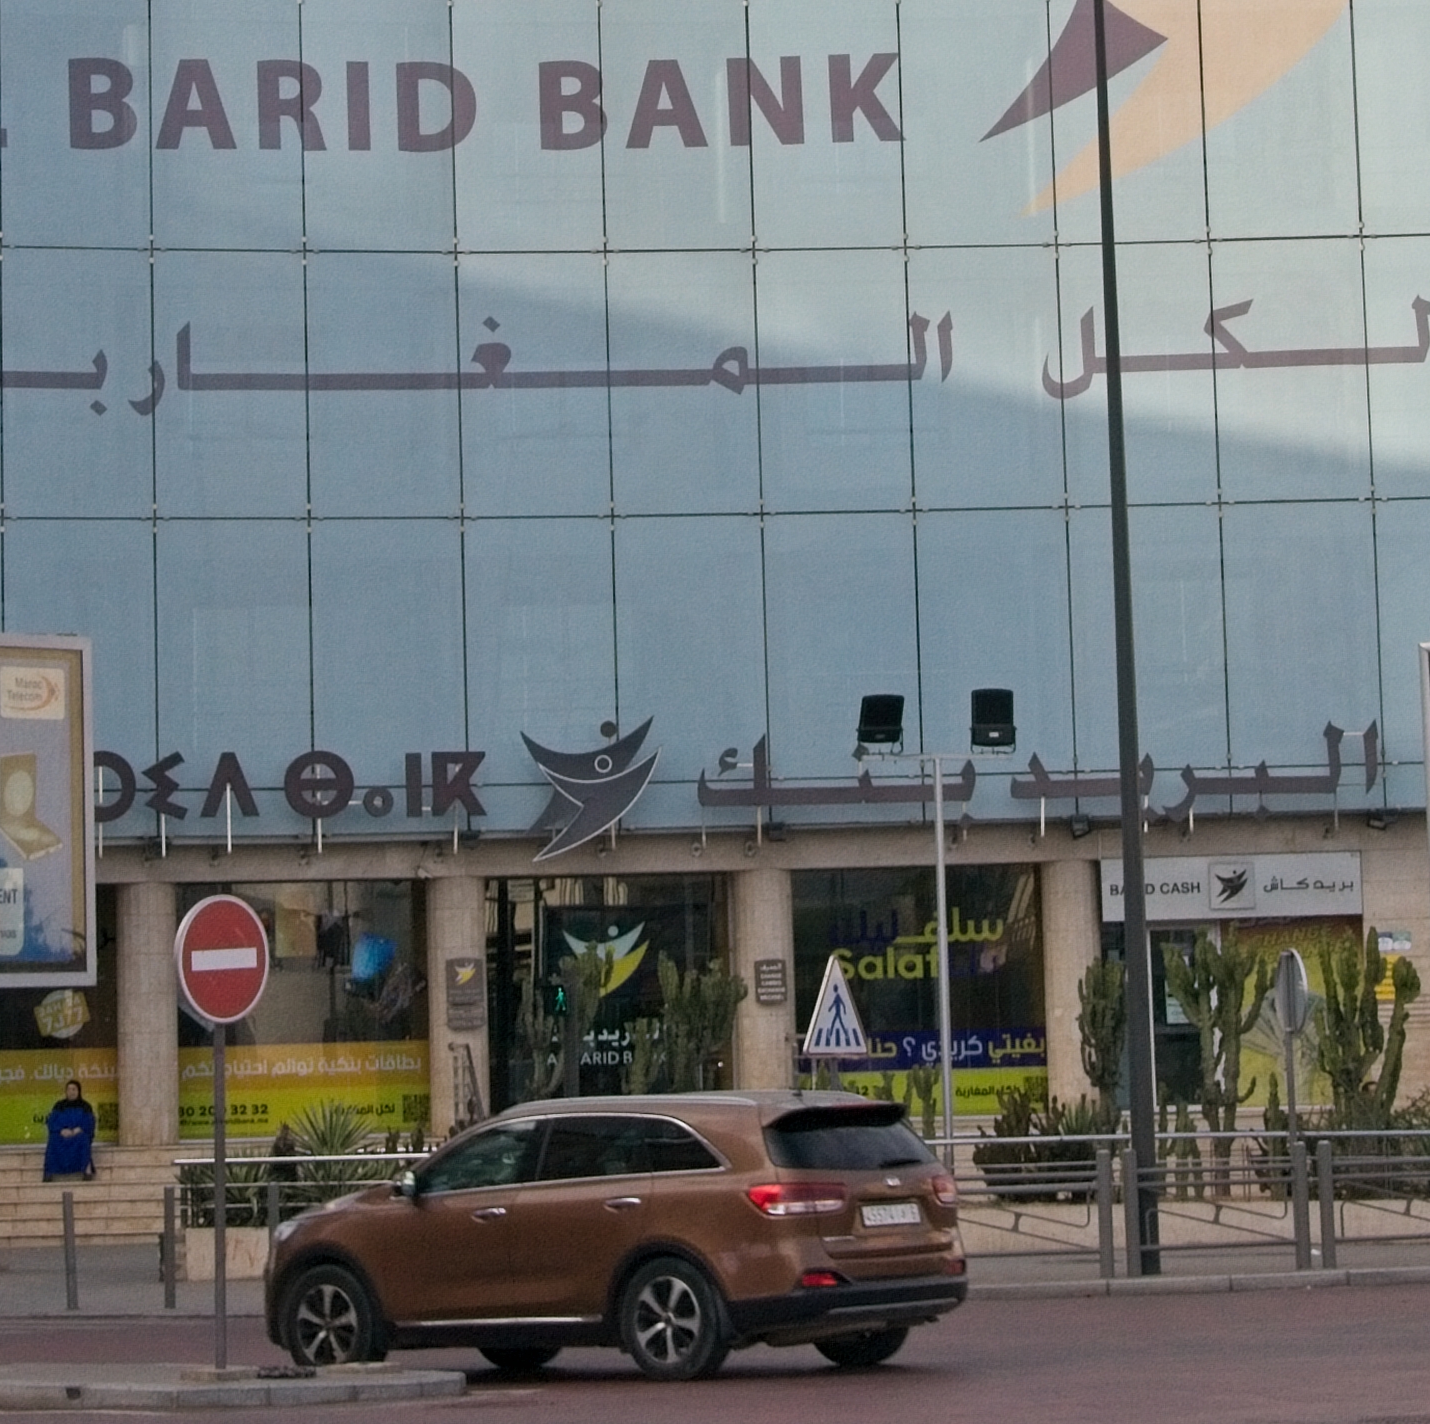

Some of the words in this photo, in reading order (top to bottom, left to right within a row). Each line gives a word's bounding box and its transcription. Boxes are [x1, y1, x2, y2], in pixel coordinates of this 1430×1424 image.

[68, 57, 477, 153] BARID
[538, 52, 905, 151] BANK
[1160, 881, 1201, 895] CASH
[580, 1051, 620, 1065] ARID
